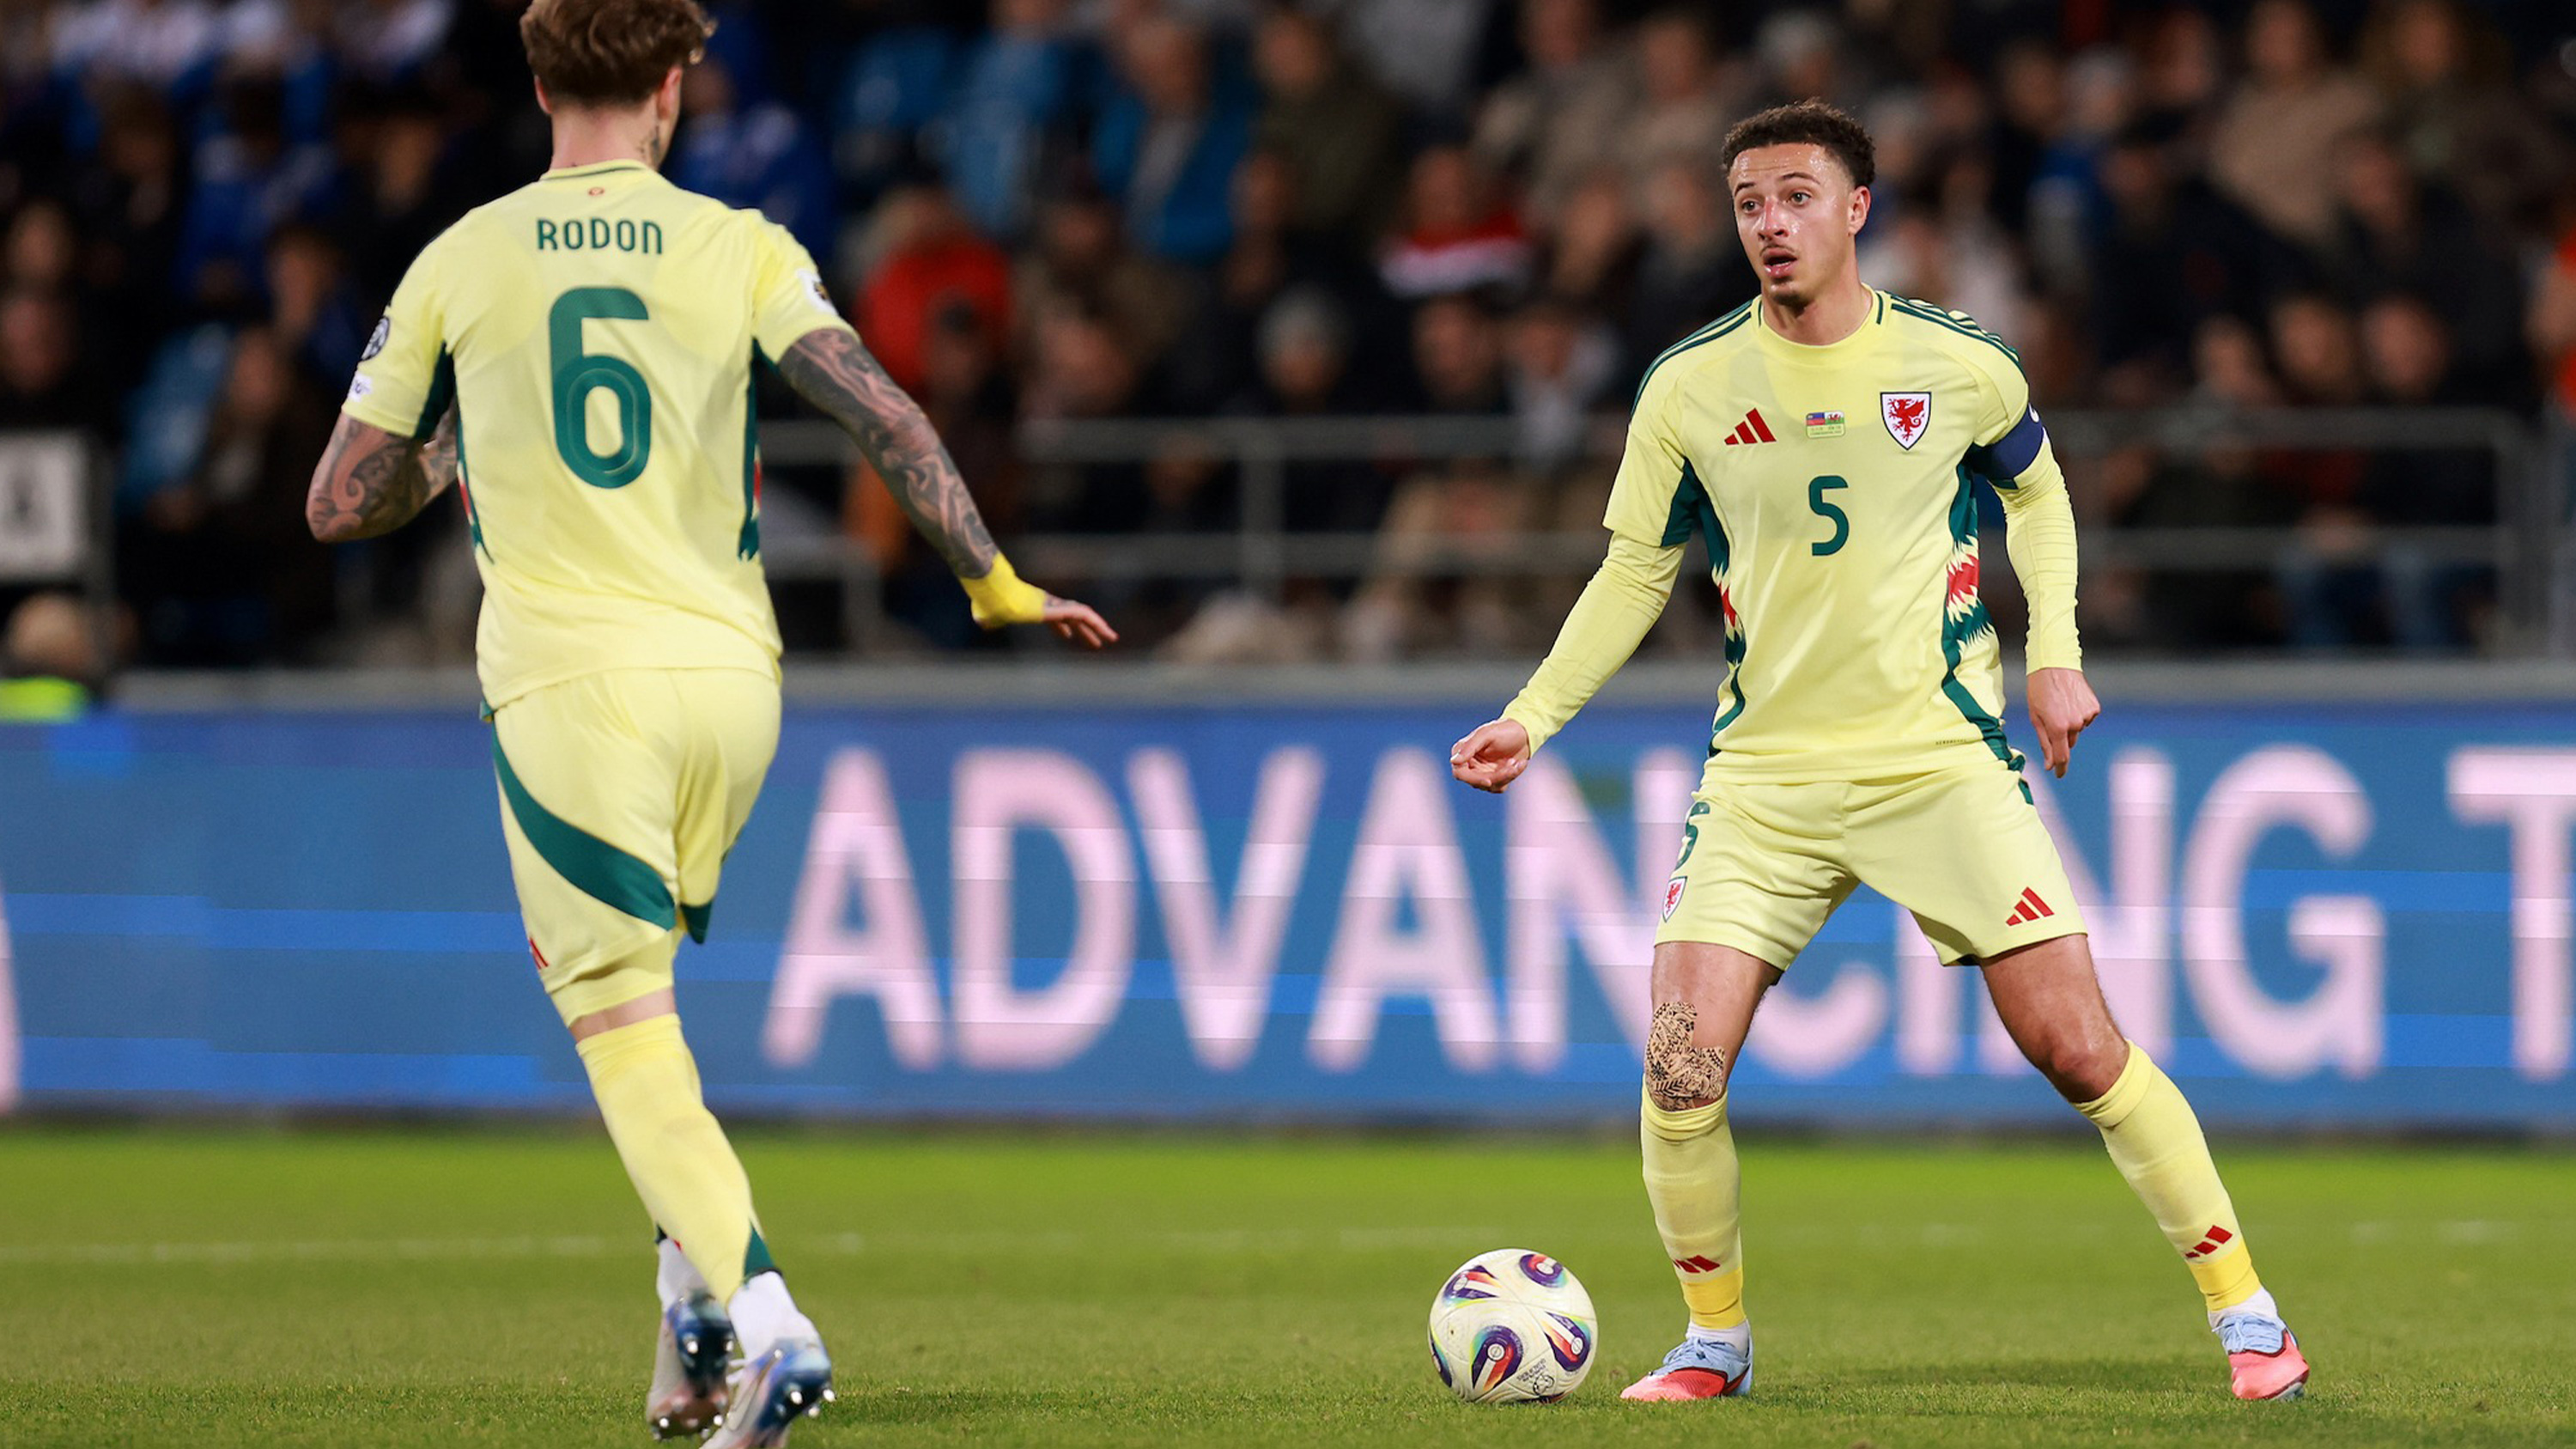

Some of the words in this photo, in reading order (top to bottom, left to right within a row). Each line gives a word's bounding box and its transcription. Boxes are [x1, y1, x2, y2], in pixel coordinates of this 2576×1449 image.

[538, 218, 662, 254] RODON
[550, 287, 653, 490] 6
[1808, 475, 1850, 557] 5
